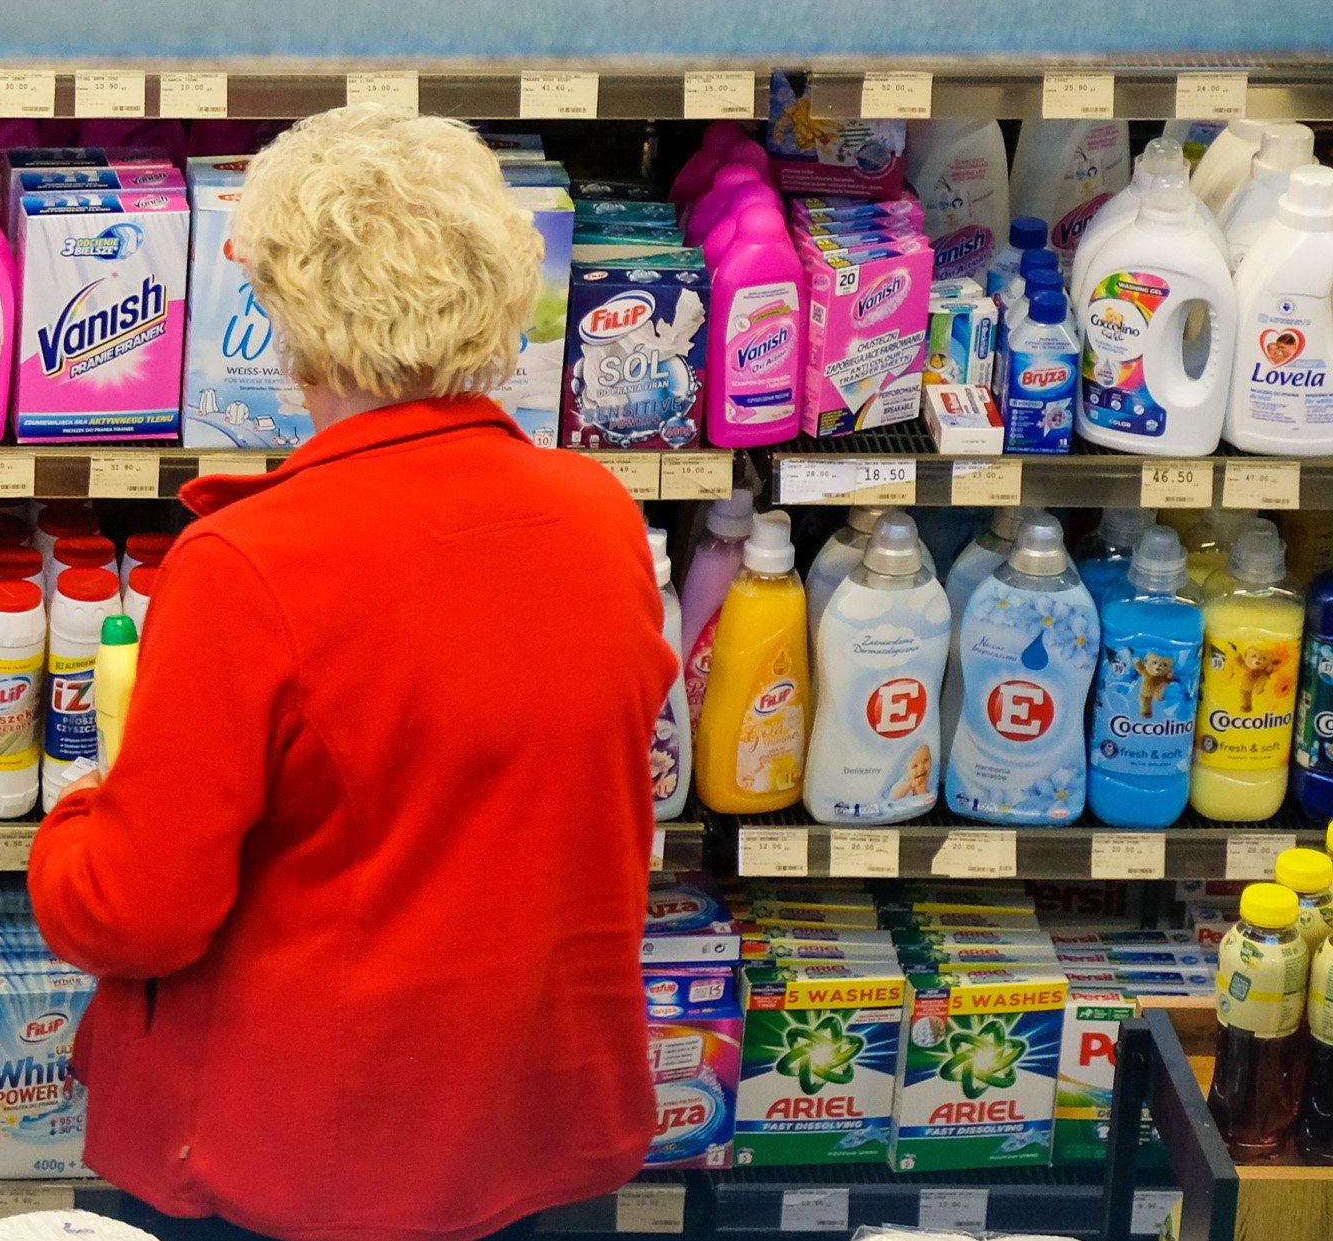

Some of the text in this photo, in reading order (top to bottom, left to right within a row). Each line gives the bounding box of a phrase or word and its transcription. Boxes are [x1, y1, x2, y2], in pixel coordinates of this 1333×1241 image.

[839, 274, 855, 287] 20
[857, 279, 901, 315] Vanish
[38, 275, 166, 376] Vanish
[1091, 314, 1140, 337] Coccolino
[737, 327, 787, 367] Vanish
[857, 333, 898, 354] CHUSTECZKI
[598, 344, 669, 386] SÓL
[1022, 369, 1067, 386] Bryza
[1252, 363, 1324, 387] Lovela
[88, 413, 174, 424] AKTYWNEGO TLENU
[864, 467, 905, 479] 18.50
[1152, 471, 1193, 484] 46.50
[877, 685, 918, 733] E
[997, 684, 1045, 735] E
[1111, 716, 1192, 738] Coccolino
[1210, 711, 1292, 732] Coccolino
[843, 766, 881, 776] Delikatny
[974, 763, 1011, 775] Harmonia
[1064, 973, 1113, 982] Persil
[788, 987, 901, 1003] 5 WASHES
[953, 990, 1064, 1008] 5 WASHES
[1070, 993, 1121, 1002] Persil
[766, 1098, 863, 1119] ARIEL
[929, 1101, 1025, 1124] ARIEL
[763, 1119, 862, 1131] FAST DISSOLVING
[925, 1123, 1025, 1137] FAST DISSOLVING
